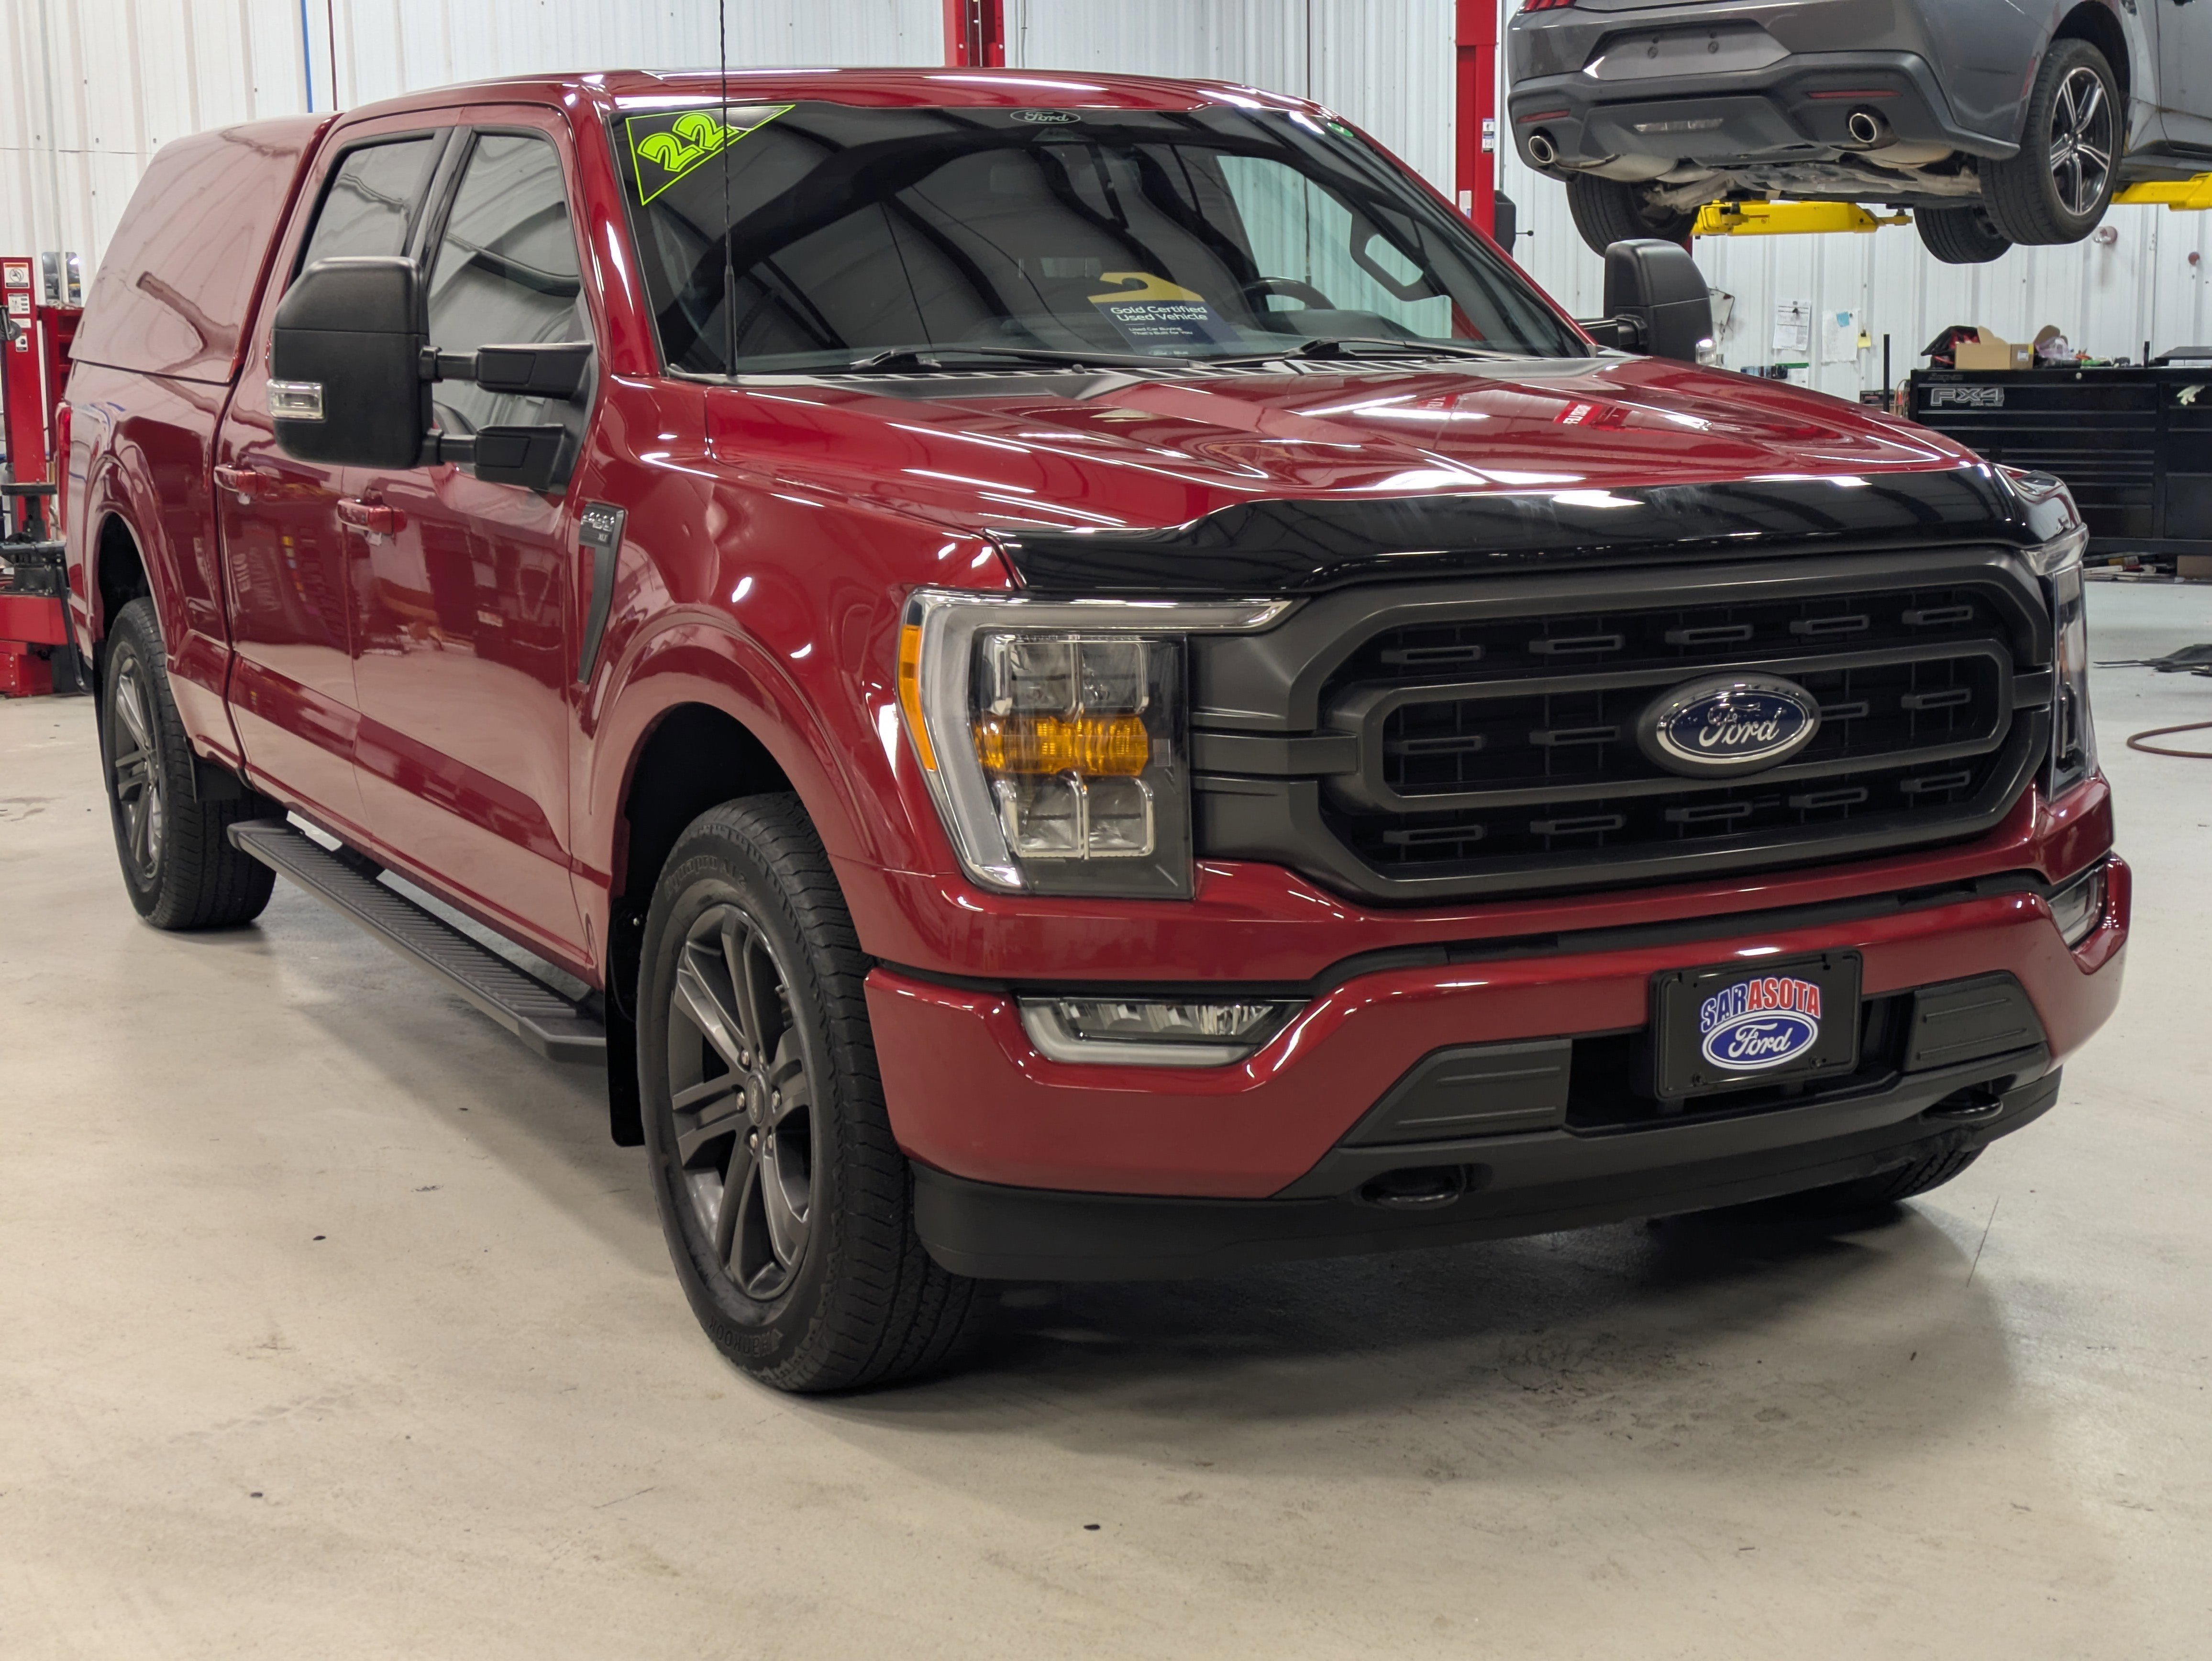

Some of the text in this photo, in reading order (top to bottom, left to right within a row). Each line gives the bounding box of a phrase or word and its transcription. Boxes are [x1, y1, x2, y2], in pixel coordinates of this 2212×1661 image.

[1024, 111, 1069, 122] Ford
[637, 112, 739, 172] 22
[1110, 306, 1146, 314] Gold
[1931, 387, 2004, 407] FX4
[598, 532, 608, 542] XLT
[1699, 702, 1782, 747] Ford
[1701, 977, 1821, 1033] SARASOTA
[1728, 1023, 1793, 1058] Ford
